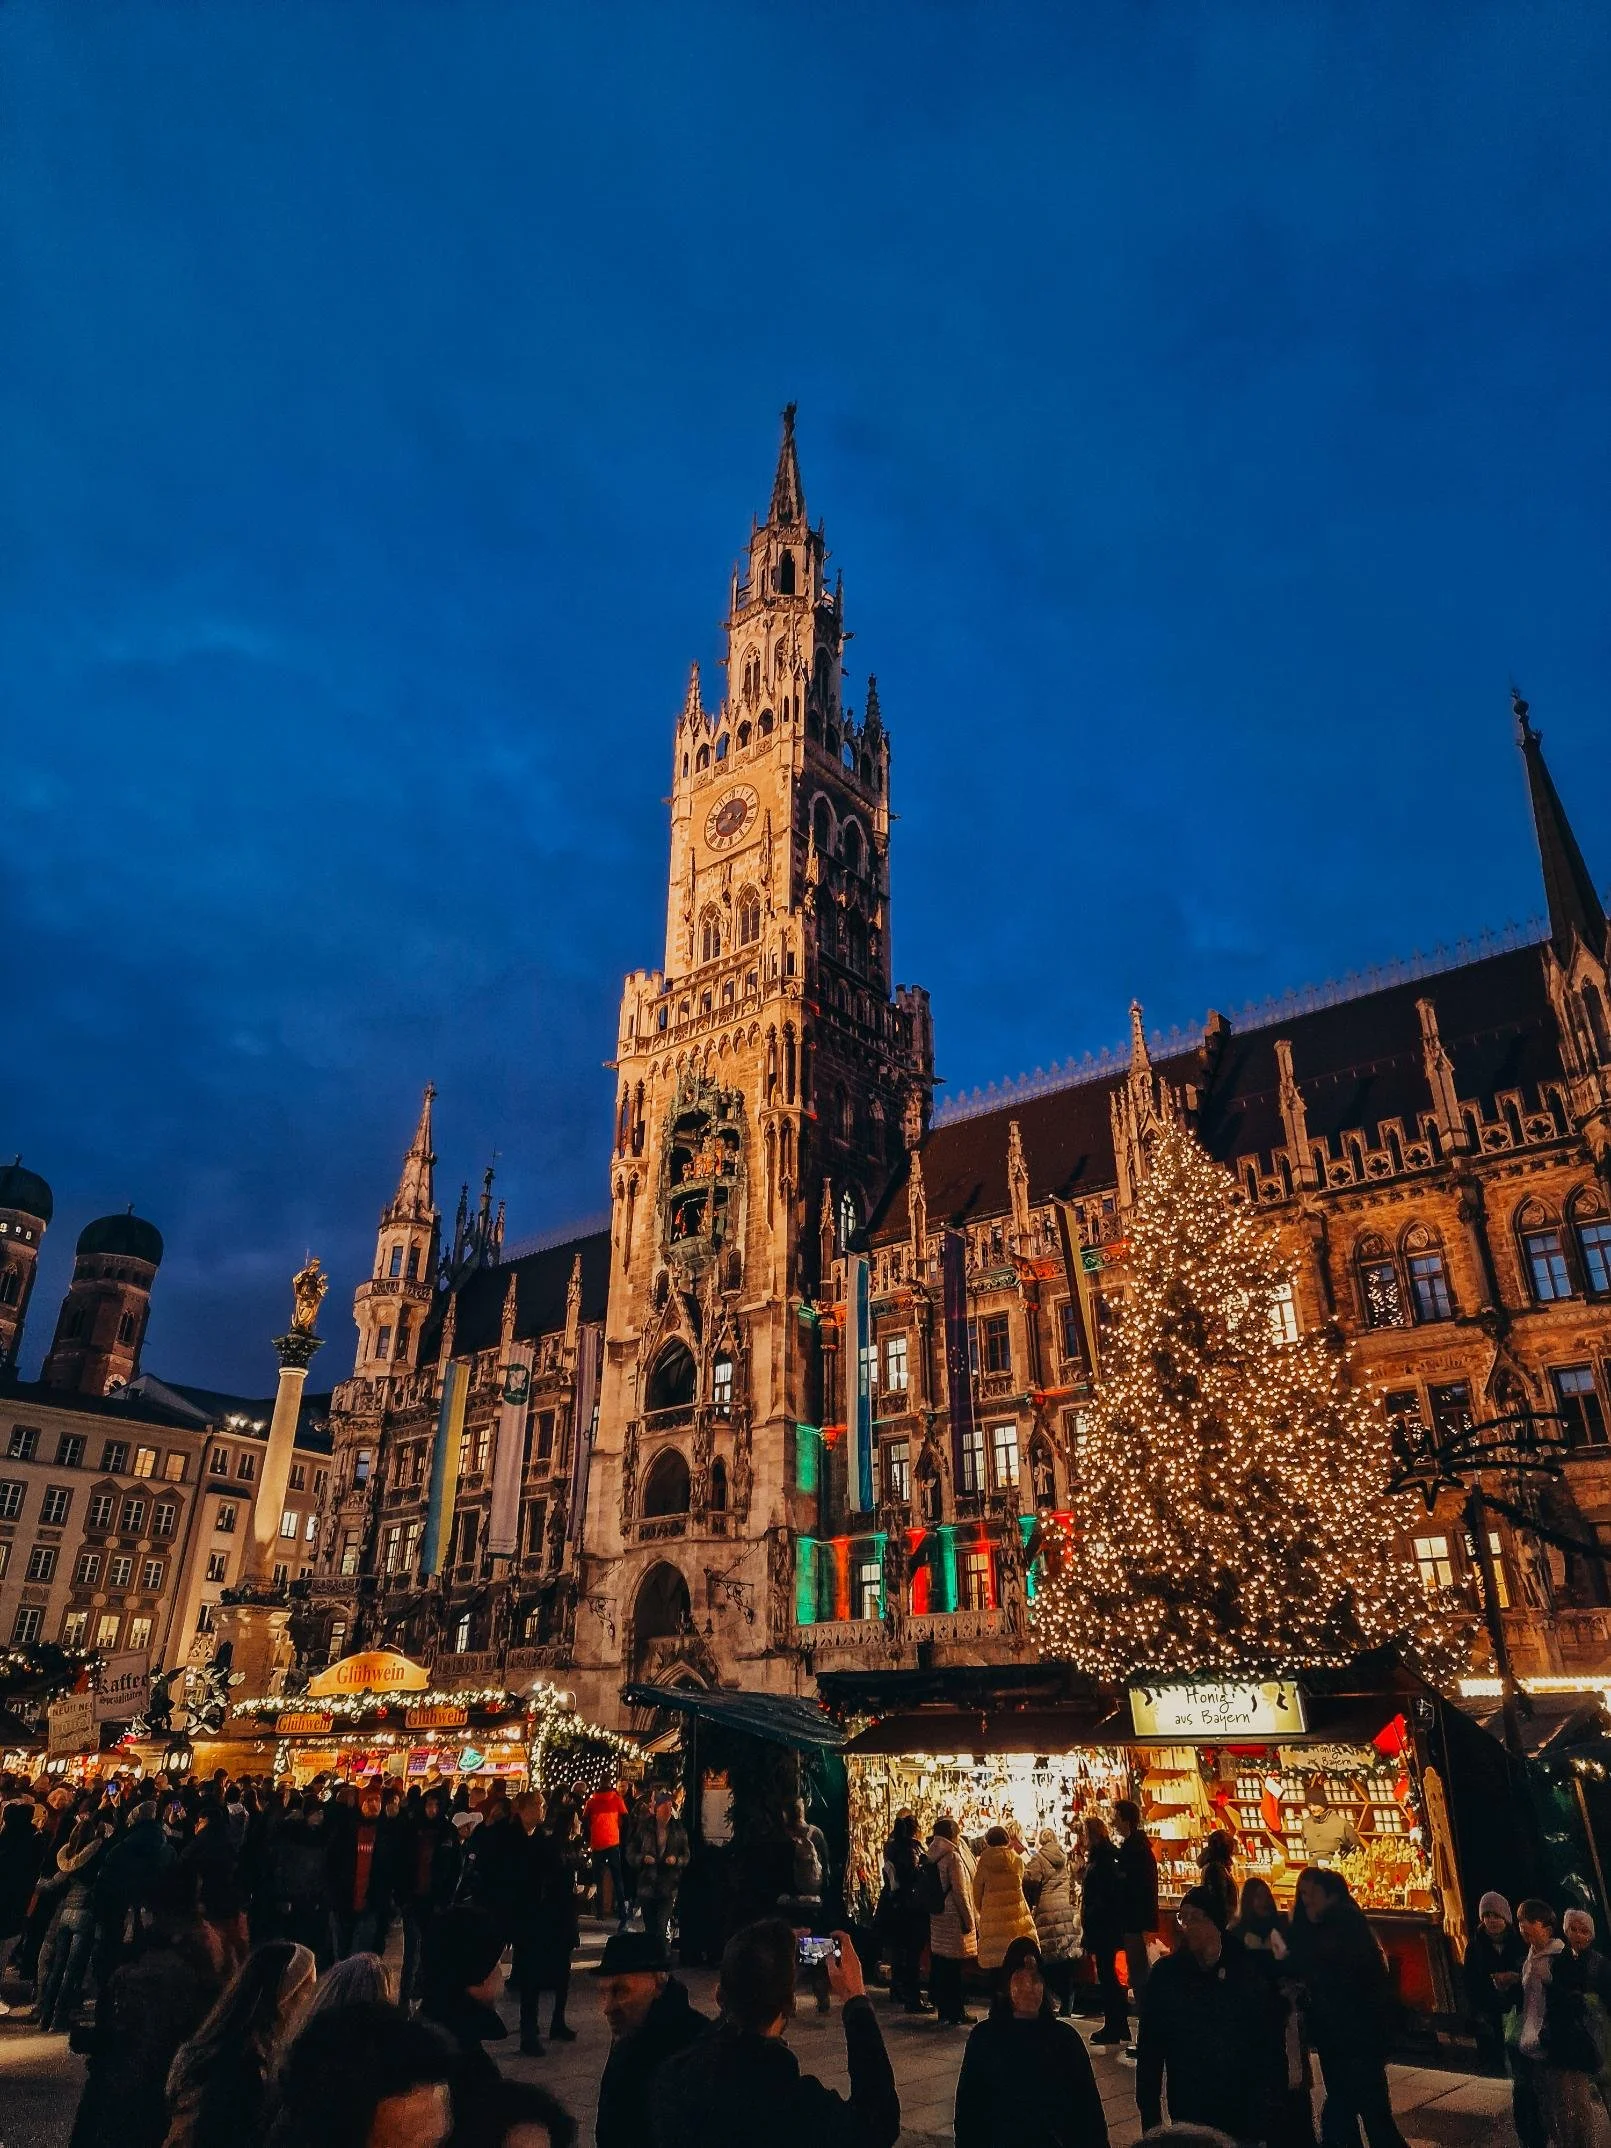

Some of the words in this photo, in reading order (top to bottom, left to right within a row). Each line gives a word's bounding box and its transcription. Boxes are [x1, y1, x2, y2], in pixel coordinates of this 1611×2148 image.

[337, 1662, 405, 1685] Glühwein
[278, 1715, 330, 1732] Glühwein
[408, 1707, 466, 1726] Glühwein
[1175, 1713, 1193, 1725] aus
[1201, 1710, 1251, 1731] Bayern
